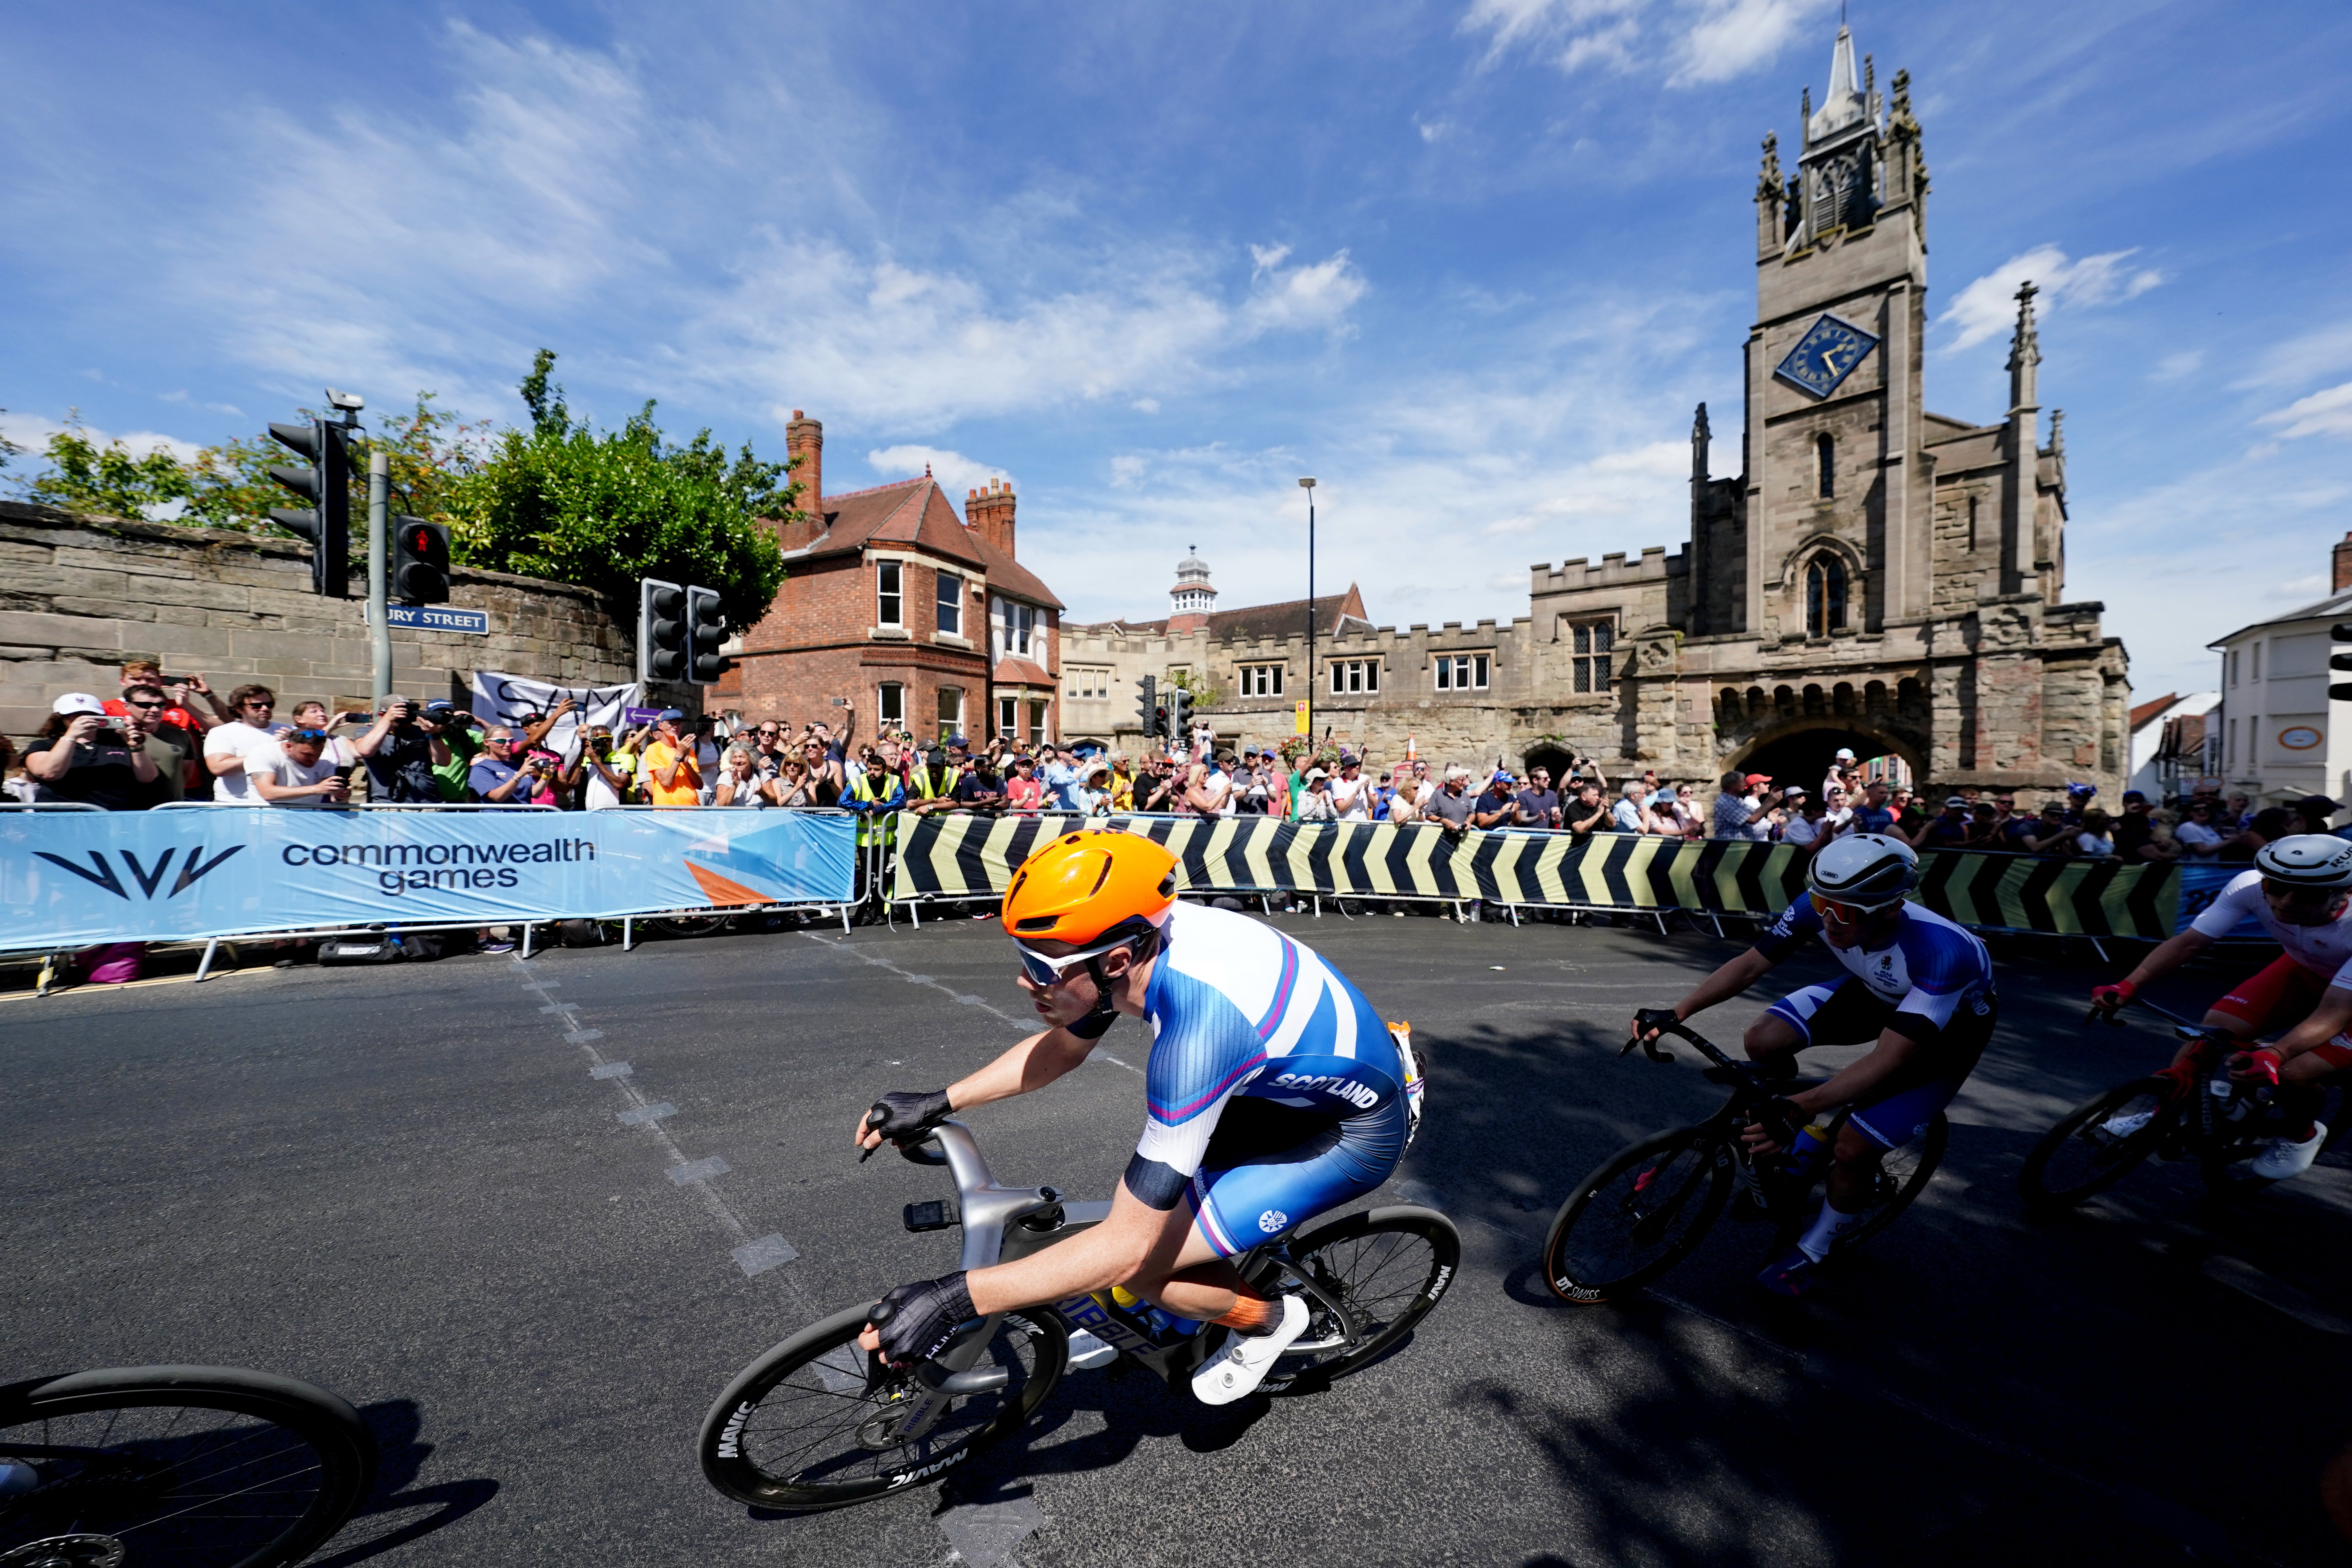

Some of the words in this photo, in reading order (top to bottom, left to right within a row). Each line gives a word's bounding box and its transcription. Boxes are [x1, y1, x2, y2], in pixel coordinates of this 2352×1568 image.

[423, 612, 482, 628] STREET
[282, 838, 594, 866] commonwealth
[379, 867, 518, 897] games
[1267, 1073, 1379, 1109] SCOTLAND
[1555, 1276, 1573, 1291] DT
[1567, 1286, 1600, 1299] SWISS
[1003, 1312, 1044, 1336] AVIC
[718, 1401, 757, 1458] MAVIC
[904, 1398, 934, 1432] RIBBLE
[887, 1448, 968, 1489] MAVIC
